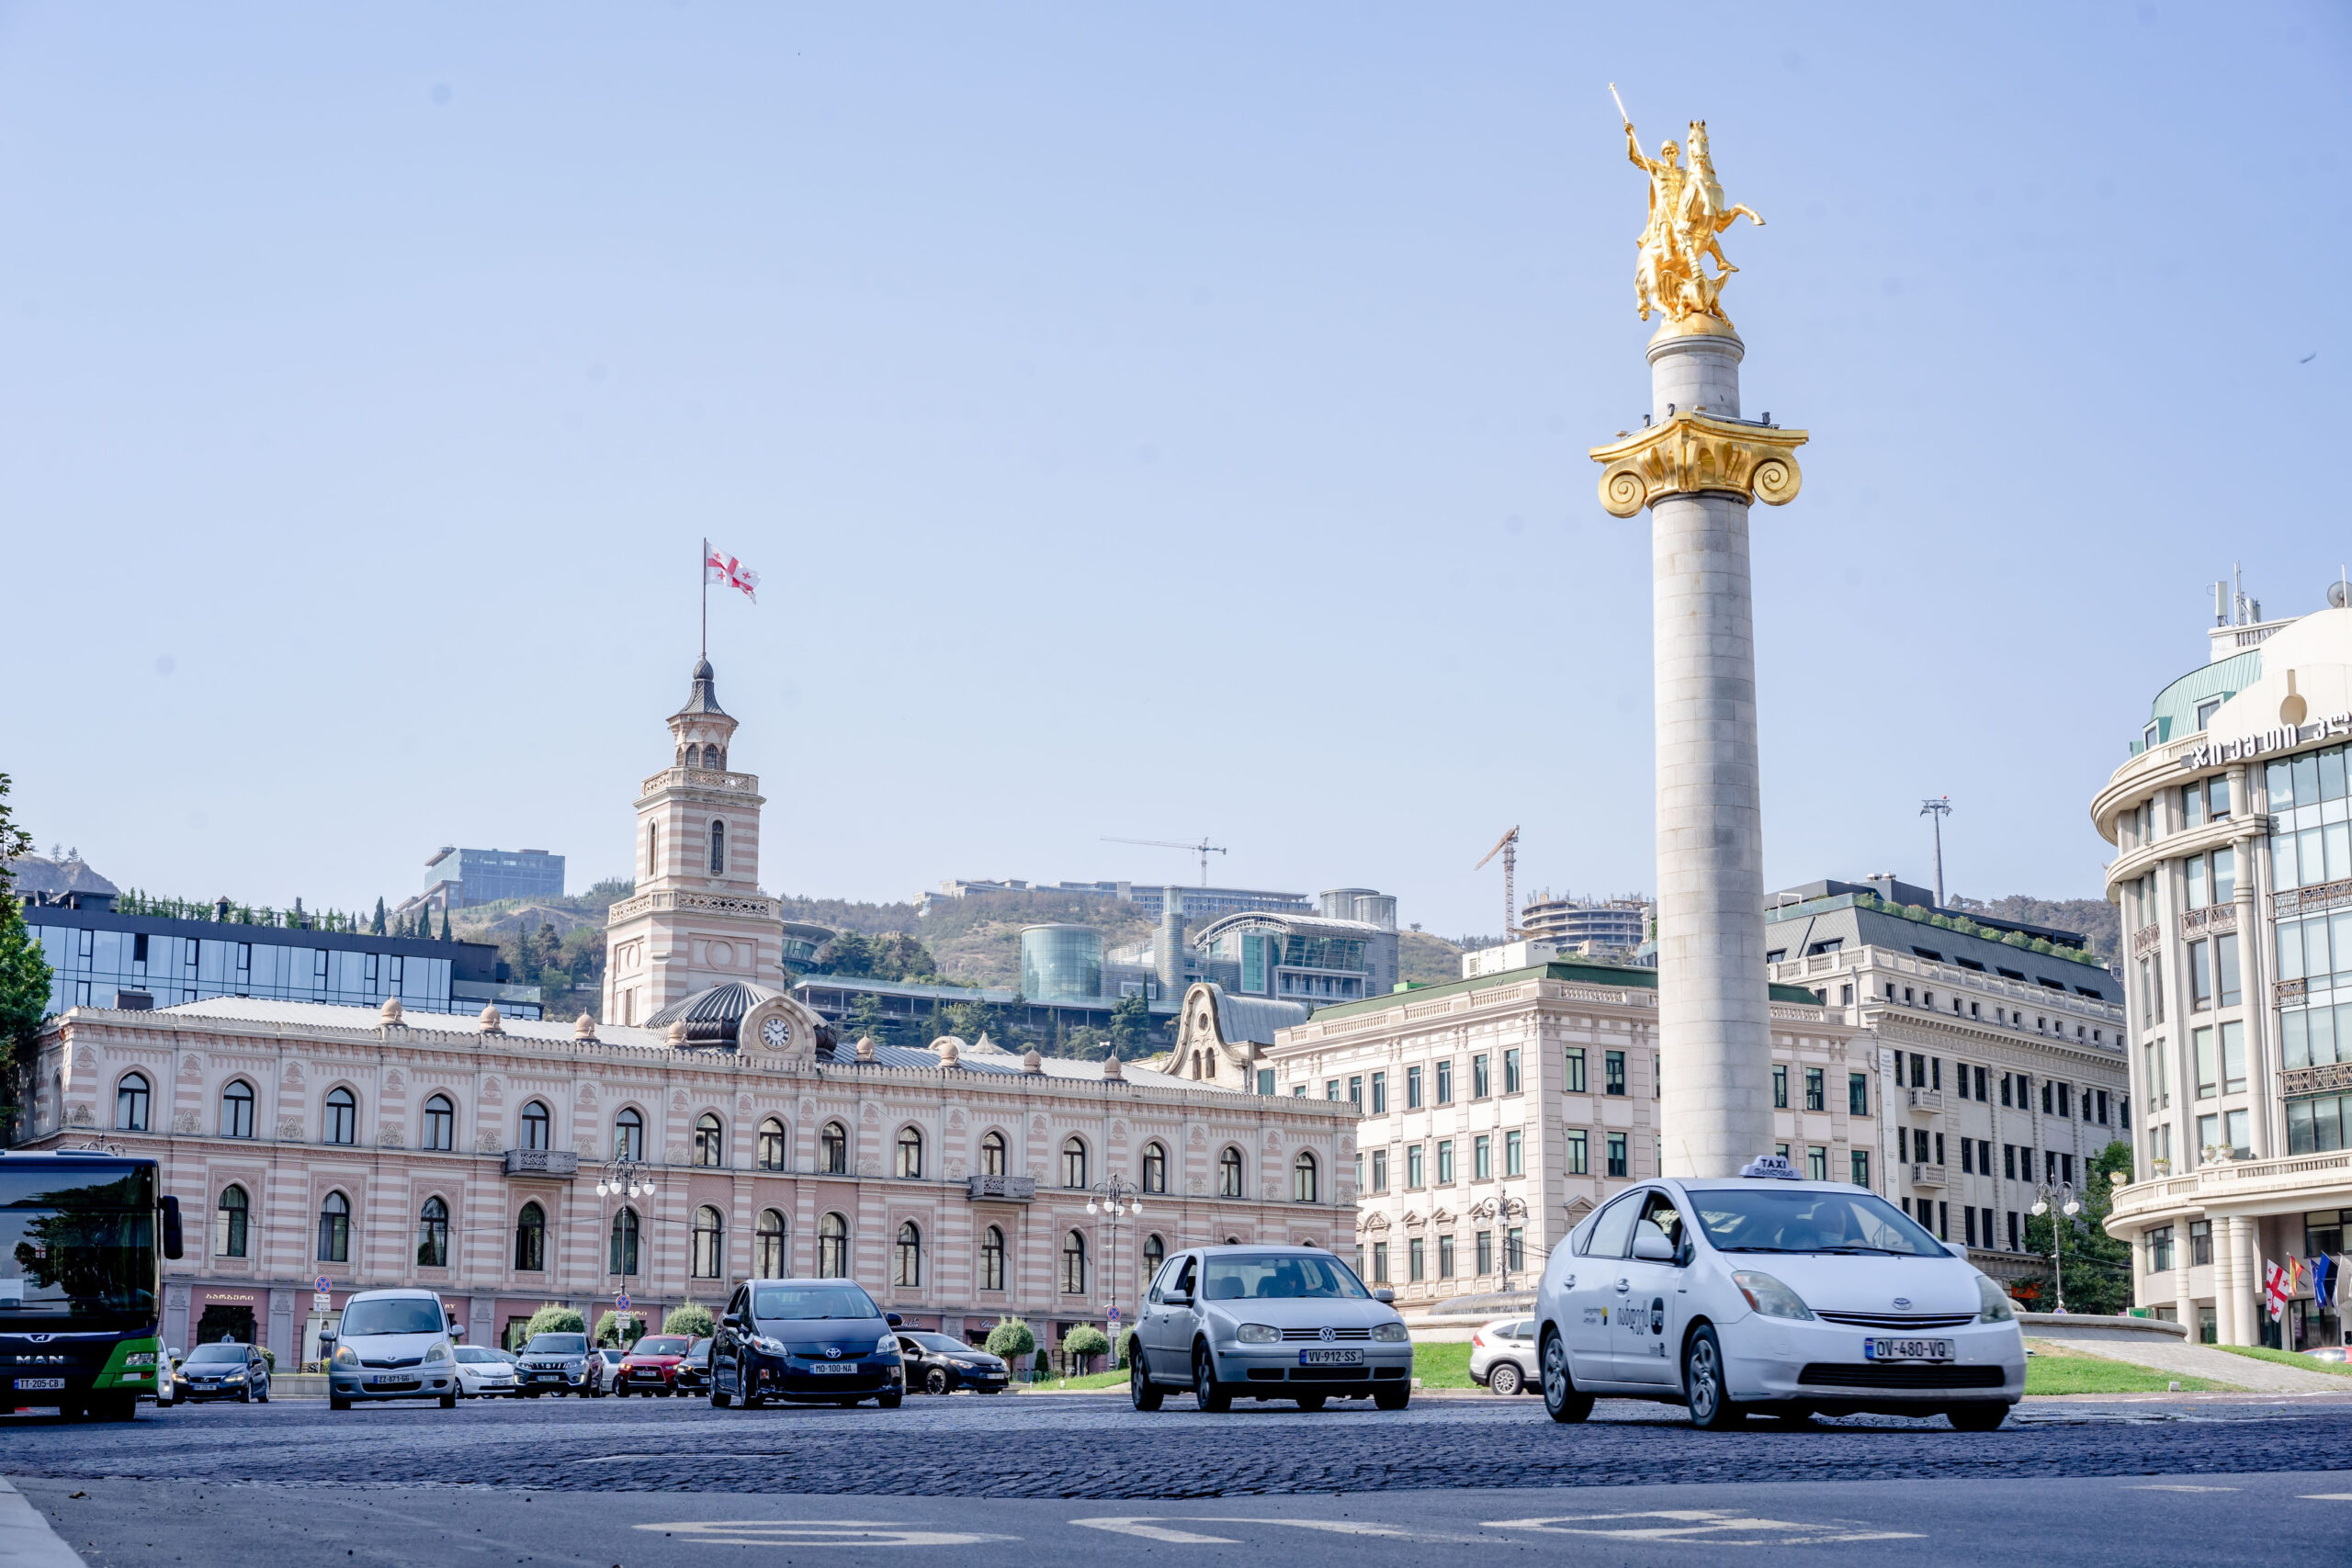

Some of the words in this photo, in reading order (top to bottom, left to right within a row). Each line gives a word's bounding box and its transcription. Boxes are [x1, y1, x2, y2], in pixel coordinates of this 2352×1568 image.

[1761, 1158, 1787, 1169] TAXI
[1876, 1341, 1945, 1357] OV-480-VQ
[17, 1355, 63, 1365] MAN
[1308, 1351, 1356, 1361] VV-912-SS
[815, 1364, 853, 1372] MO-100-NA
[20, 1380, 59, 1388] TT-205-CB
